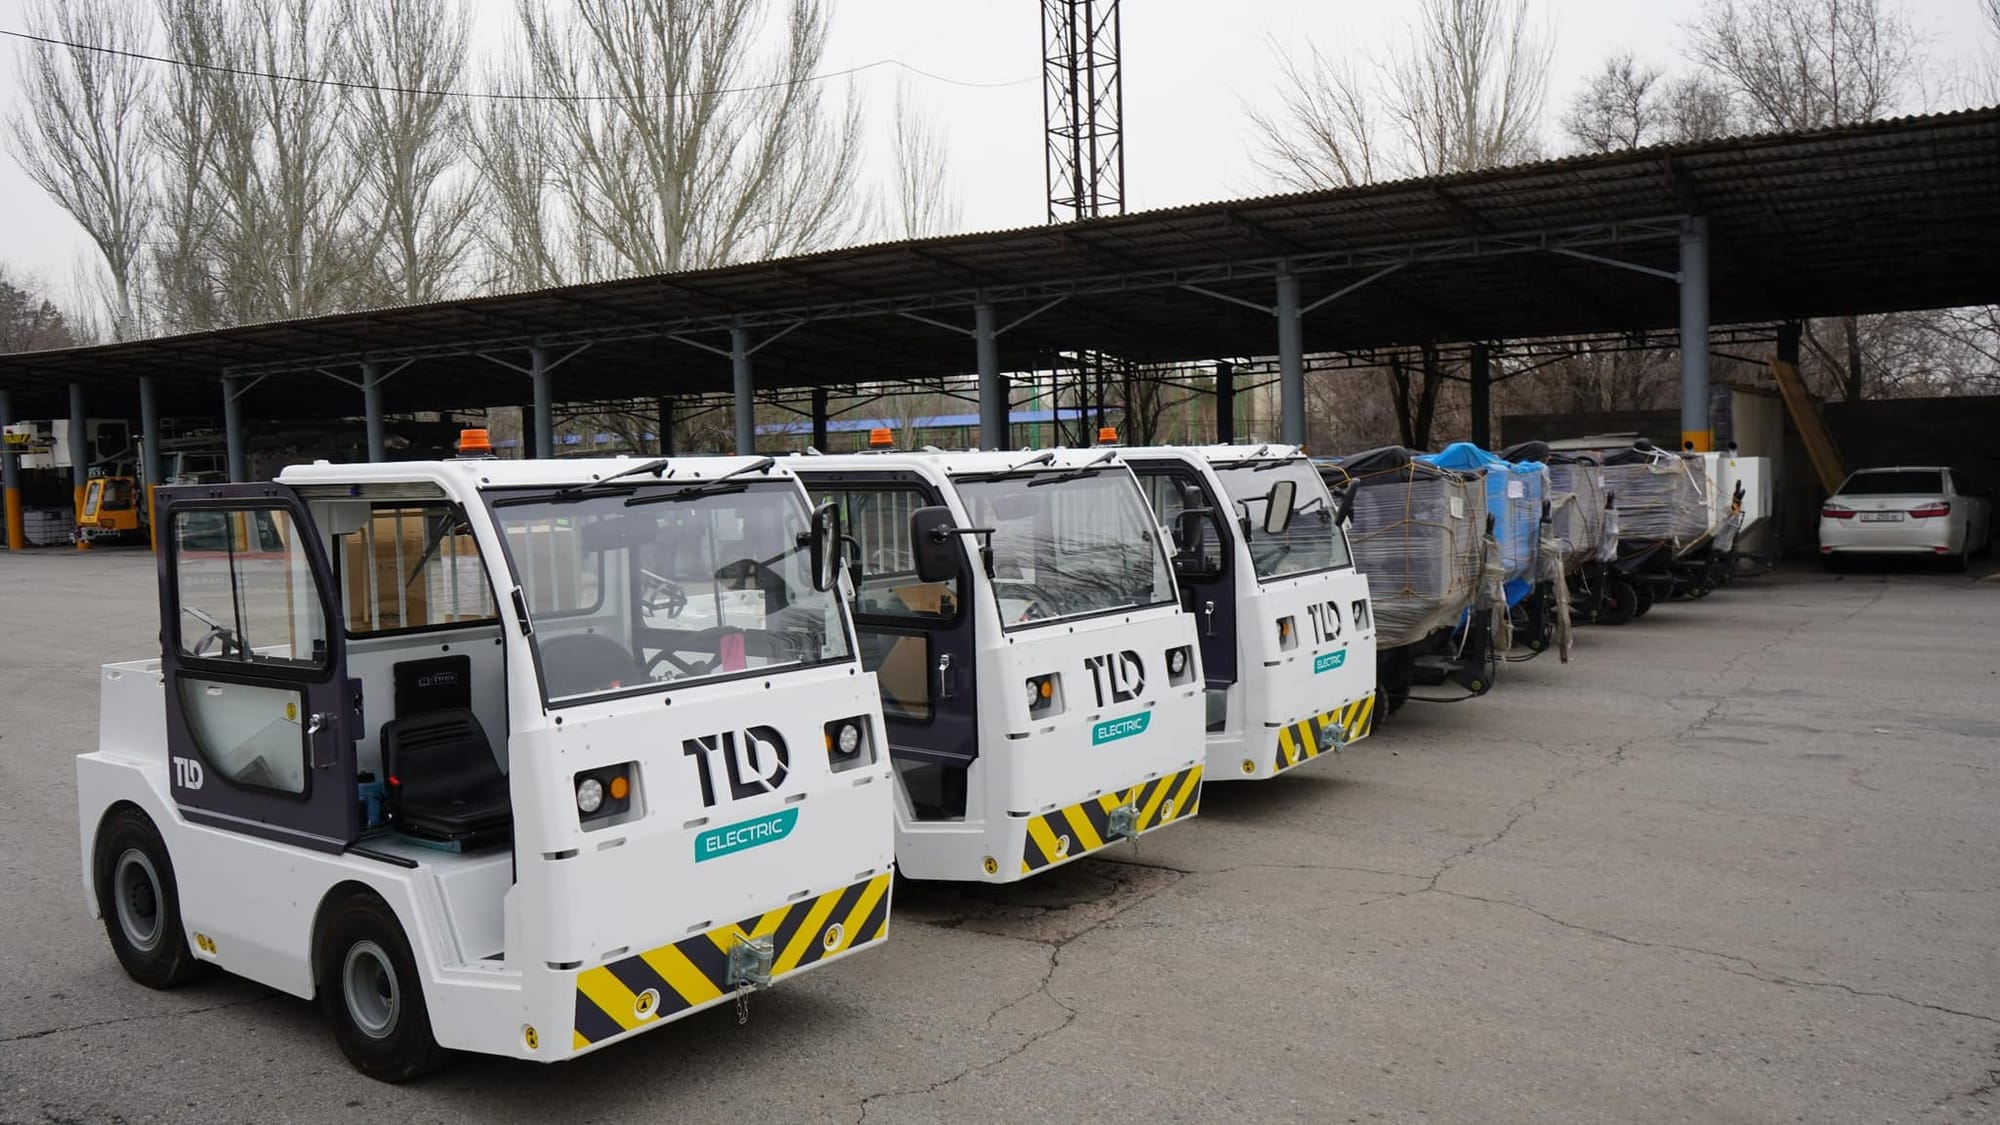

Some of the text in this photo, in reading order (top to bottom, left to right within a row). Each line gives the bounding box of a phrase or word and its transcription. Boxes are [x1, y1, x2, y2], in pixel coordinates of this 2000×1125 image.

[1307, 600, 1341, 644] TLD
[1084, 650, 1145, 707] TLD
[1098, 718, 1142, 739] ELECTRIC
[173, 756, 204, 790] TLD
[682, 725, 790, 807] TLD
[706, 818, 783, 852] ELECTRIC
